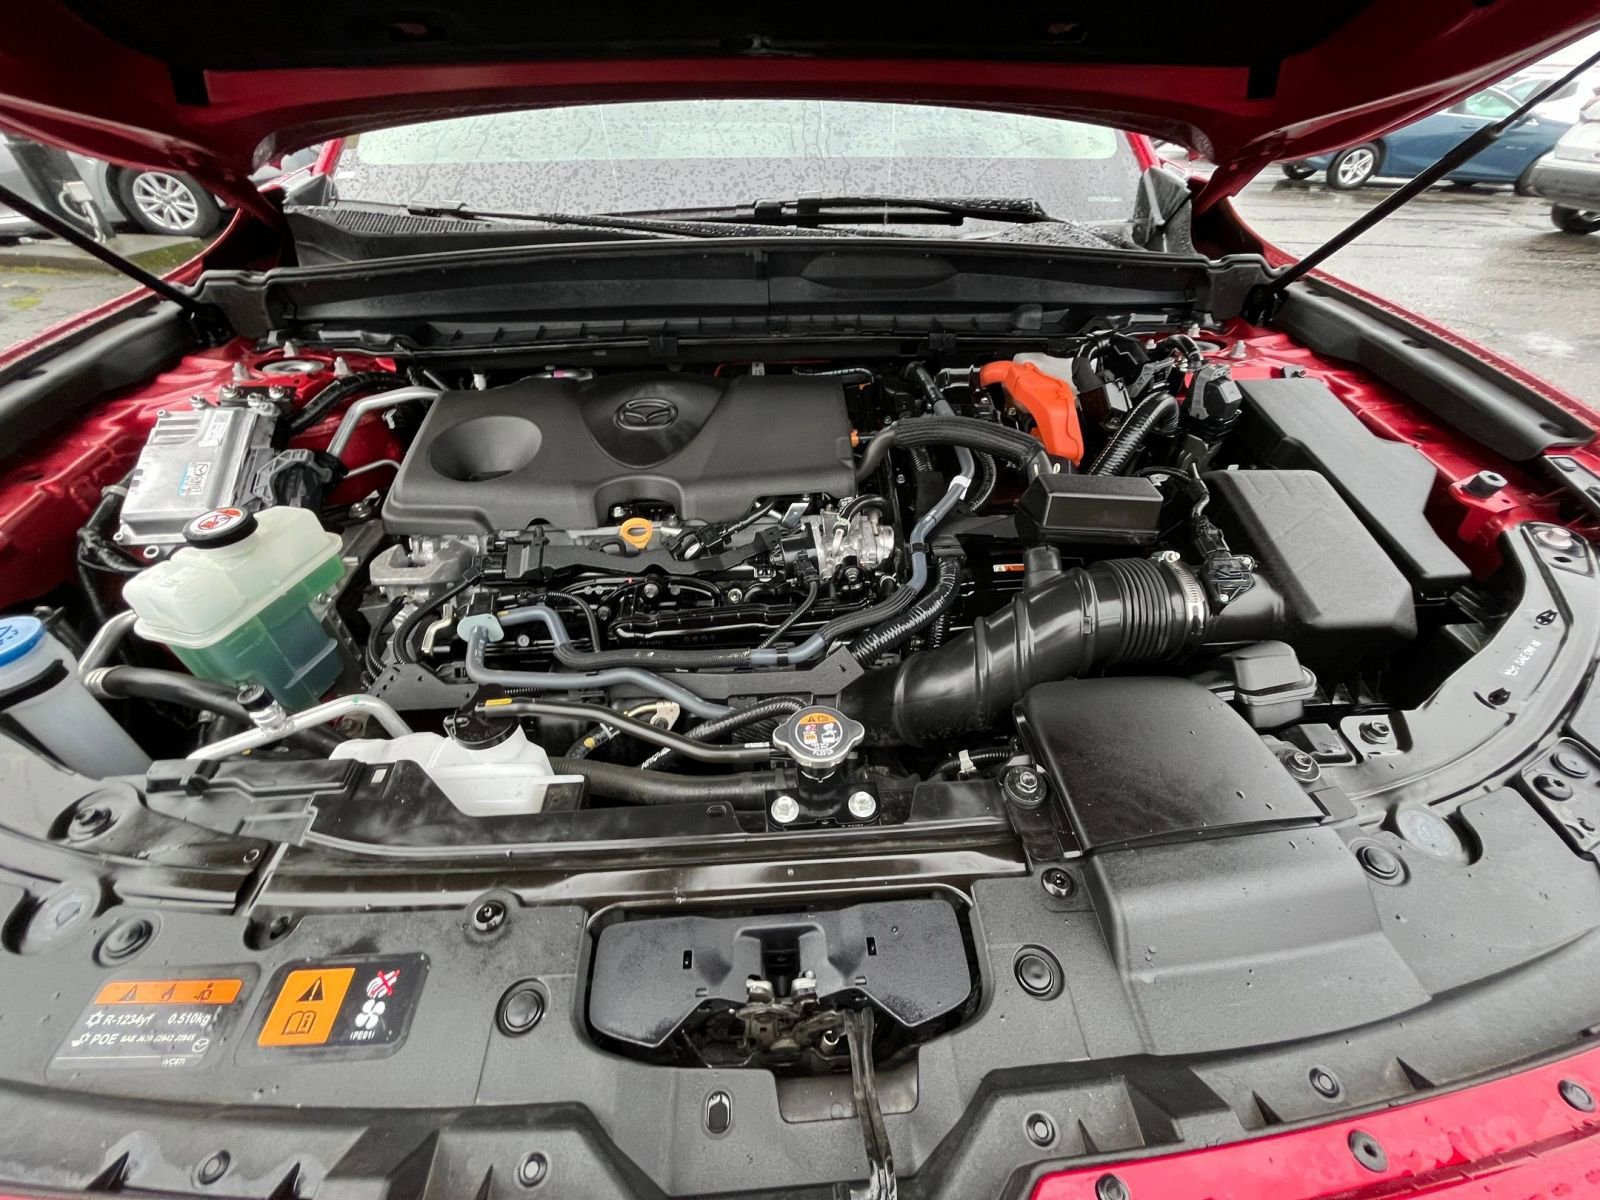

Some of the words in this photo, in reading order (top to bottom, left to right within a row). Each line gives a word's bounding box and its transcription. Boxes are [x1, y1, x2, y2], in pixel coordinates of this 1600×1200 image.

[102, 1012, 155, 1028] R-1234yf
[167, 1012, 211, 1027] 0.510kg
[89, 1033, 119, 1045] POE
